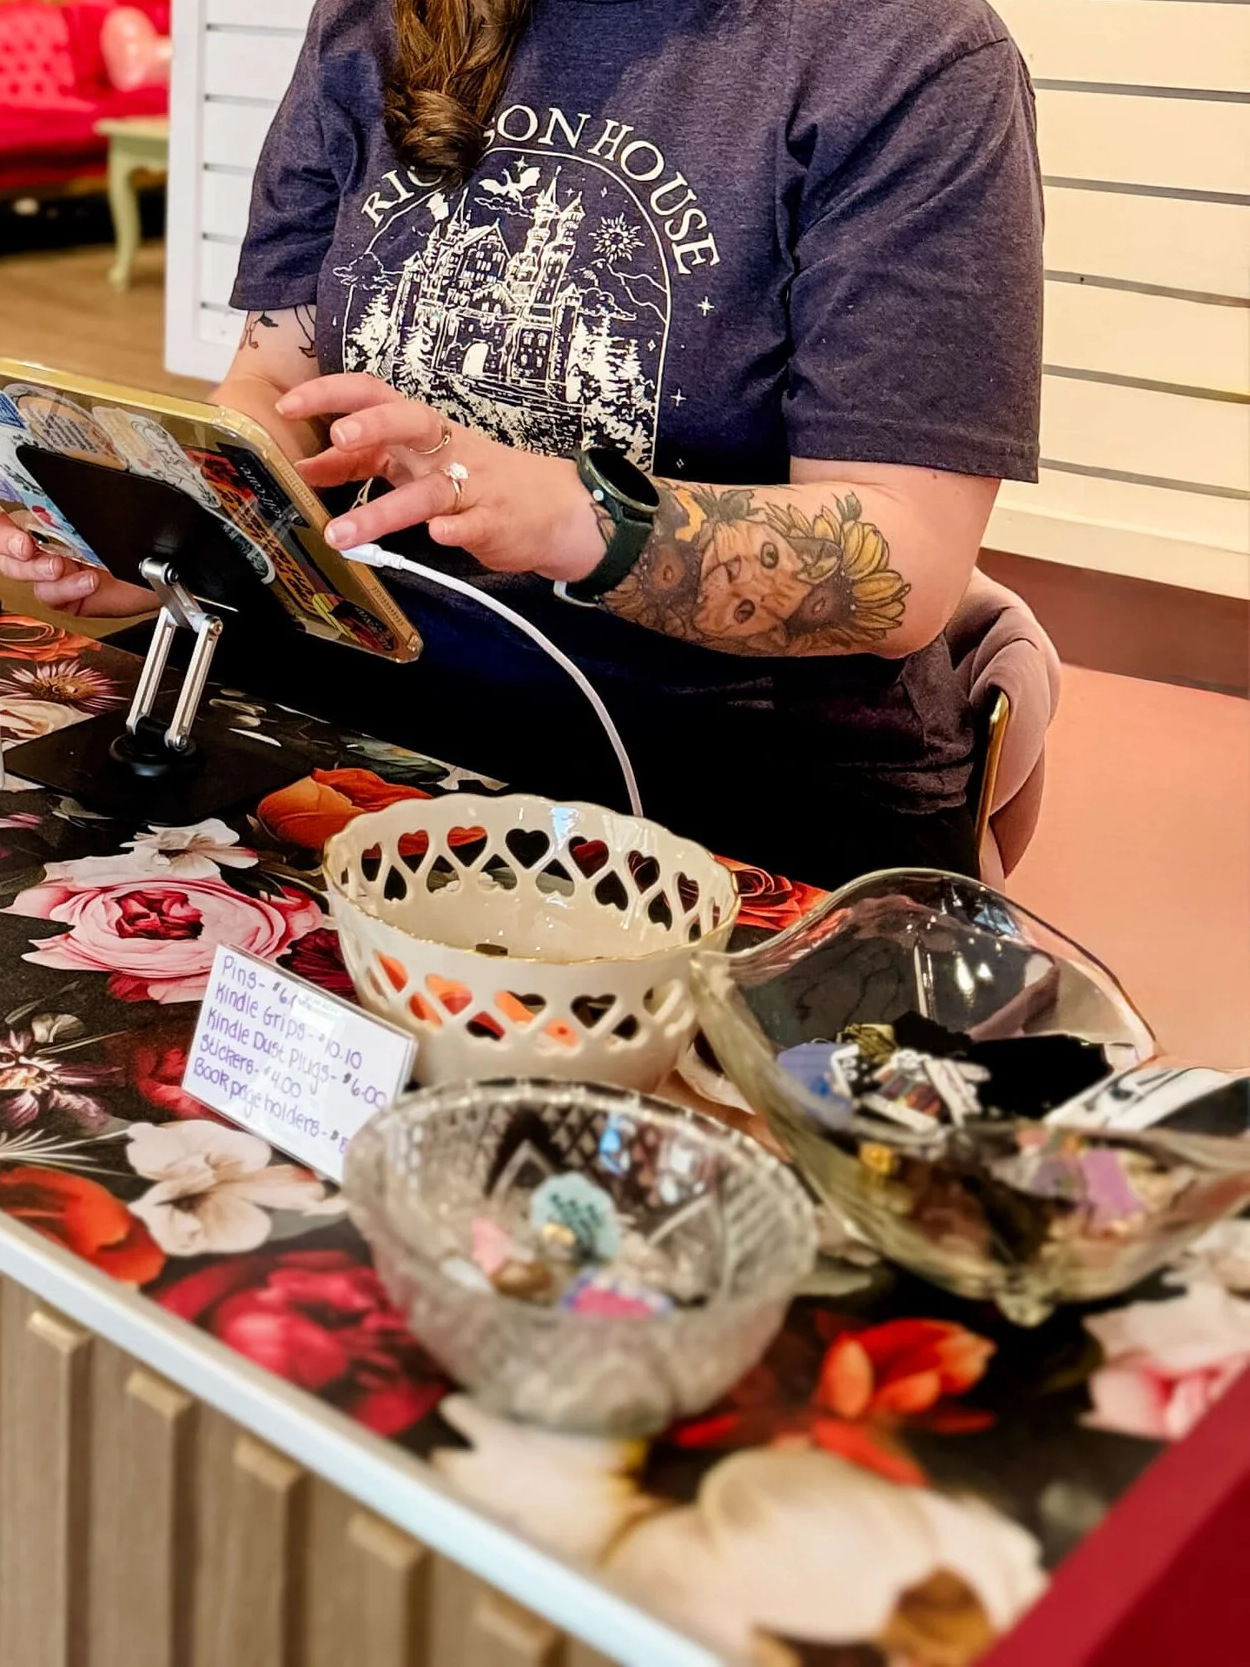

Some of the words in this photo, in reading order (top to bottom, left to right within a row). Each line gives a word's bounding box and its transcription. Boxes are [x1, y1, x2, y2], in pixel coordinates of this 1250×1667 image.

[587, 119, 721, 275] HOUSE
[207, 1006, 250, 1045] Kindle
[253, 1031, 286, 1062] Dust
[216, 981, 259, 1019] Kindle
[318, 1033, 363, 1070] $10.10
